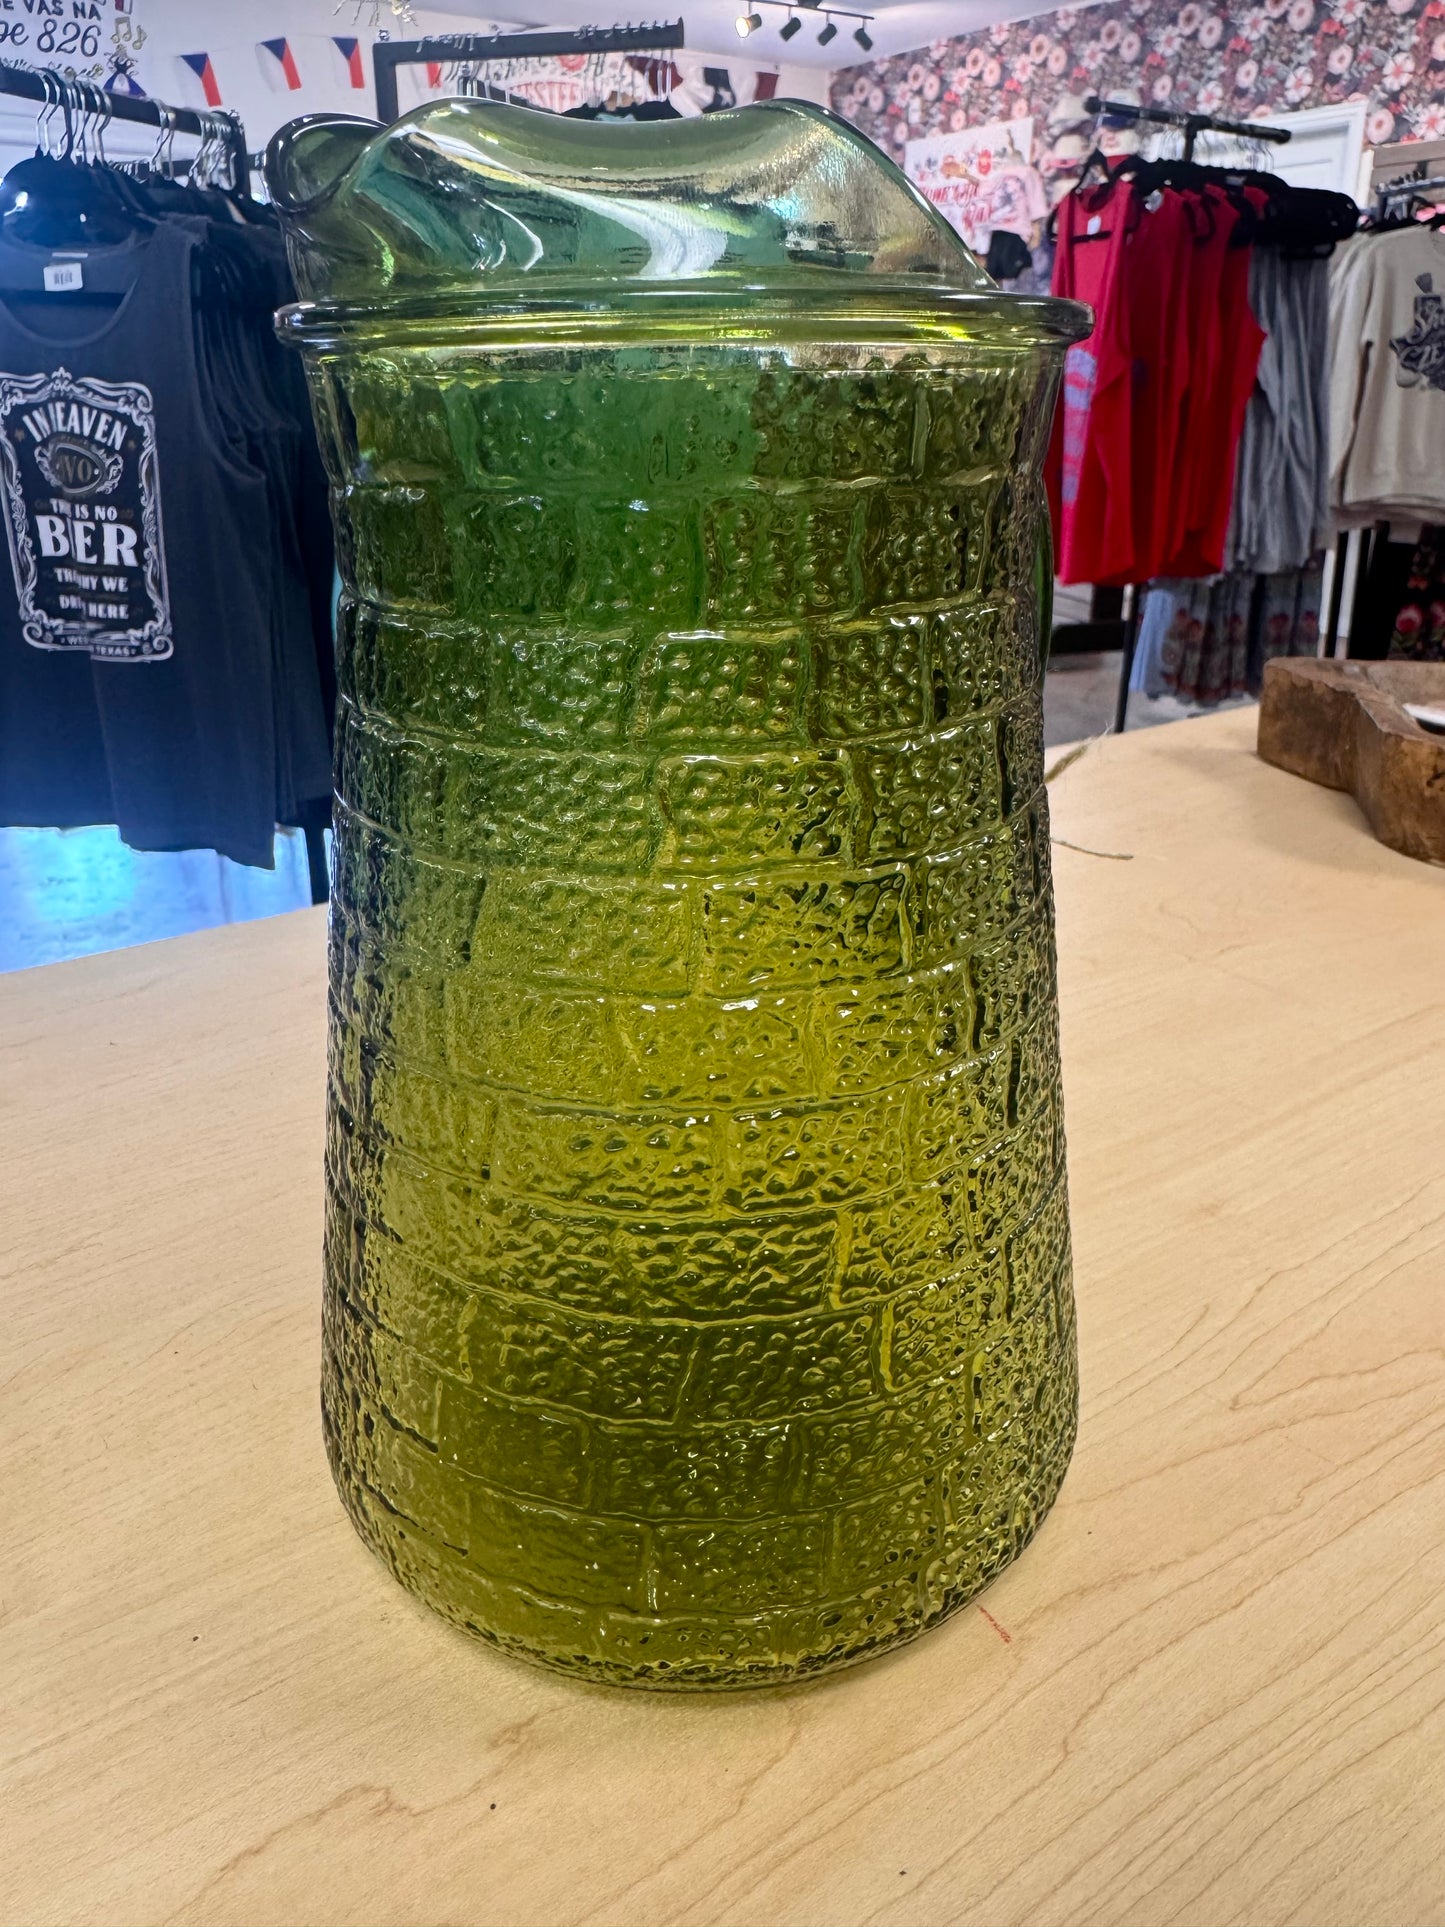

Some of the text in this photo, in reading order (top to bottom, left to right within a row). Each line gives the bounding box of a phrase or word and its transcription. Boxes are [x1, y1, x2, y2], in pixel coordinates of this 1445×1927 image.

[72, 1, 102, 21] NA
[37, 18, 102, 57] 826
[75, 503, 89, 519] IS
[95, 505, 118, 521] NO
[35, 515, 139, 567] BER
[102, 576, 129, 592] WE
[88, 602, 129, 619] HERE
